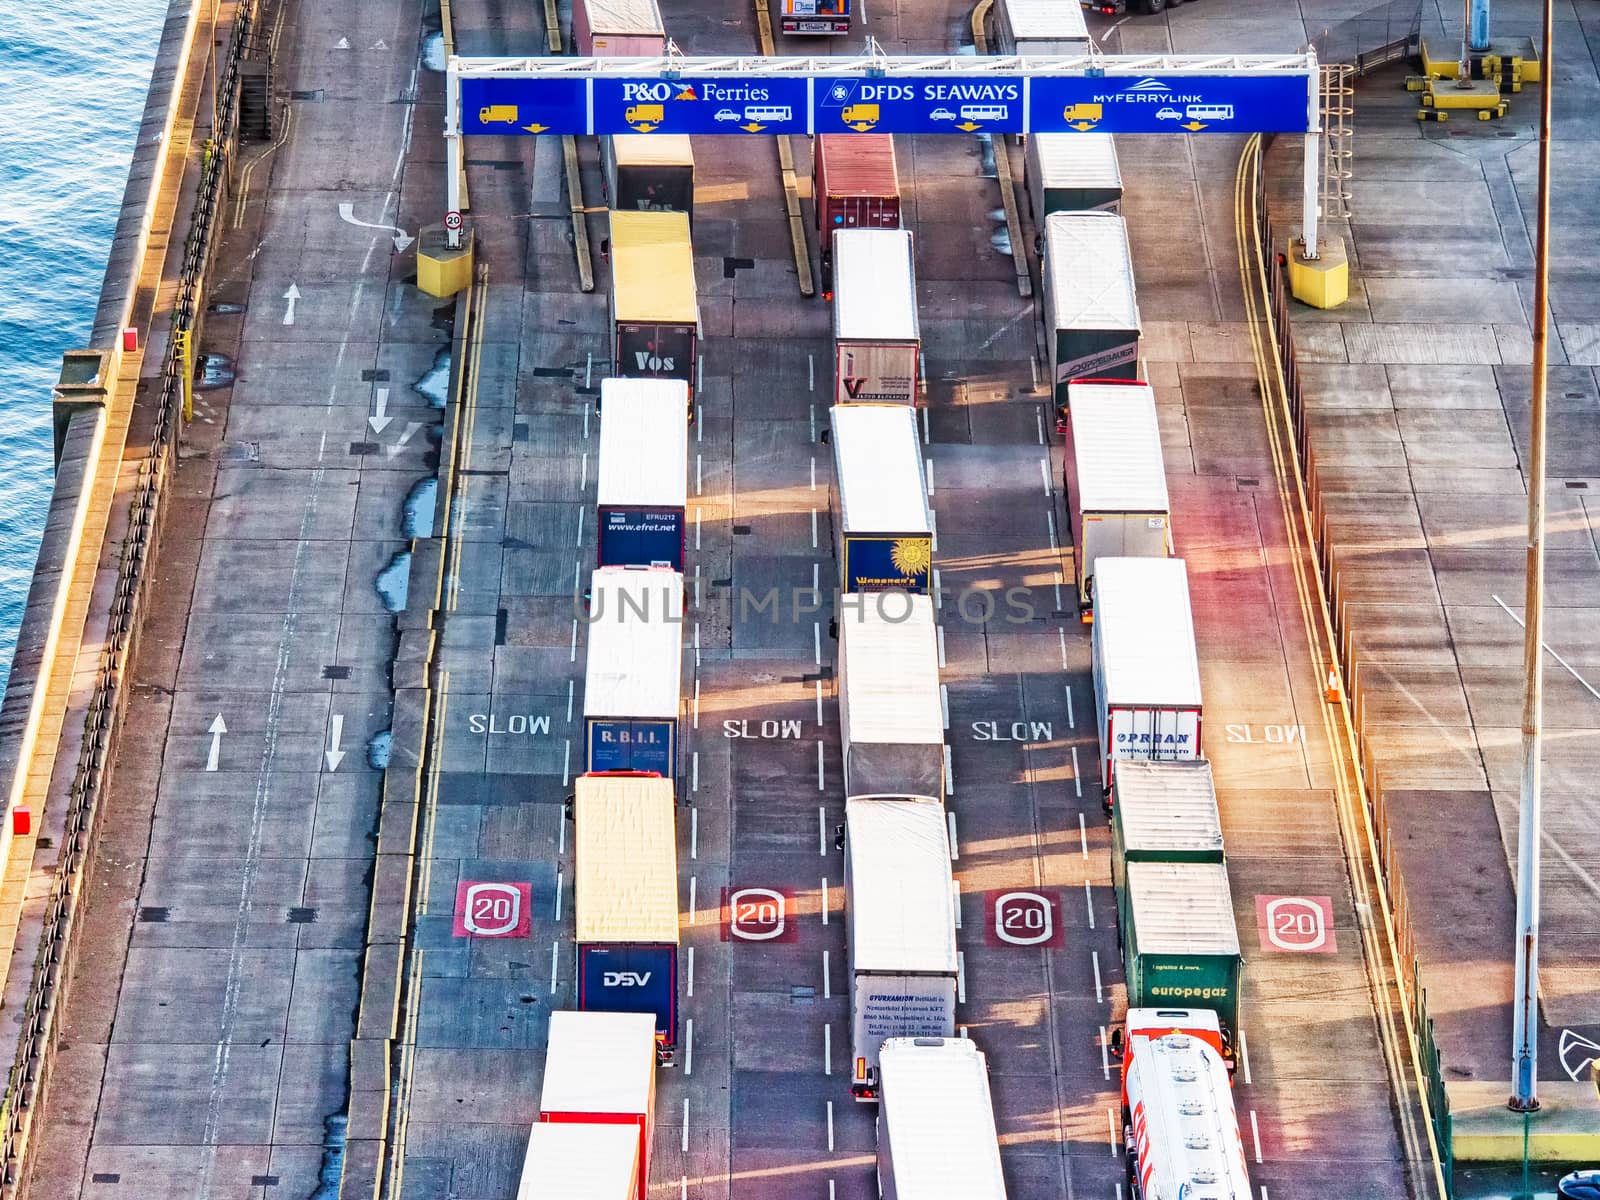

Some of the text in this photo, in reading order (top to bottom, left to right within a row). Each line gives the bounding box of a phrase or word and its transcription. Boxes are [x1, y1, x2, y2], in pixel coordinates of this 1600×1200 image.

[622, 83, 769, 101] P&O Ferries
[861, 85, 1018, 101] DFDS SEAWAYS
[1093, 94, 1203, 103] MYFERRYLINK
[447, 216, 460, 225] 20
[635, 352, 675, 371] Vos
[608, 523, 676, 532] www.efret.net
[469, 714, 550, 735] SLOW
[723, 719, 802, 740] SLOW
[972, 721, 1052, 741] SLOW
[1225, 724, 1306, 744] SLOW
[474, 898, 510, 921] 20
[738, 902, 776, 925] 20
[1006, 907, 1043, 929] 20
[1275, 913, 1316, 935] 20
[603, 971, 652, 987] DSV
